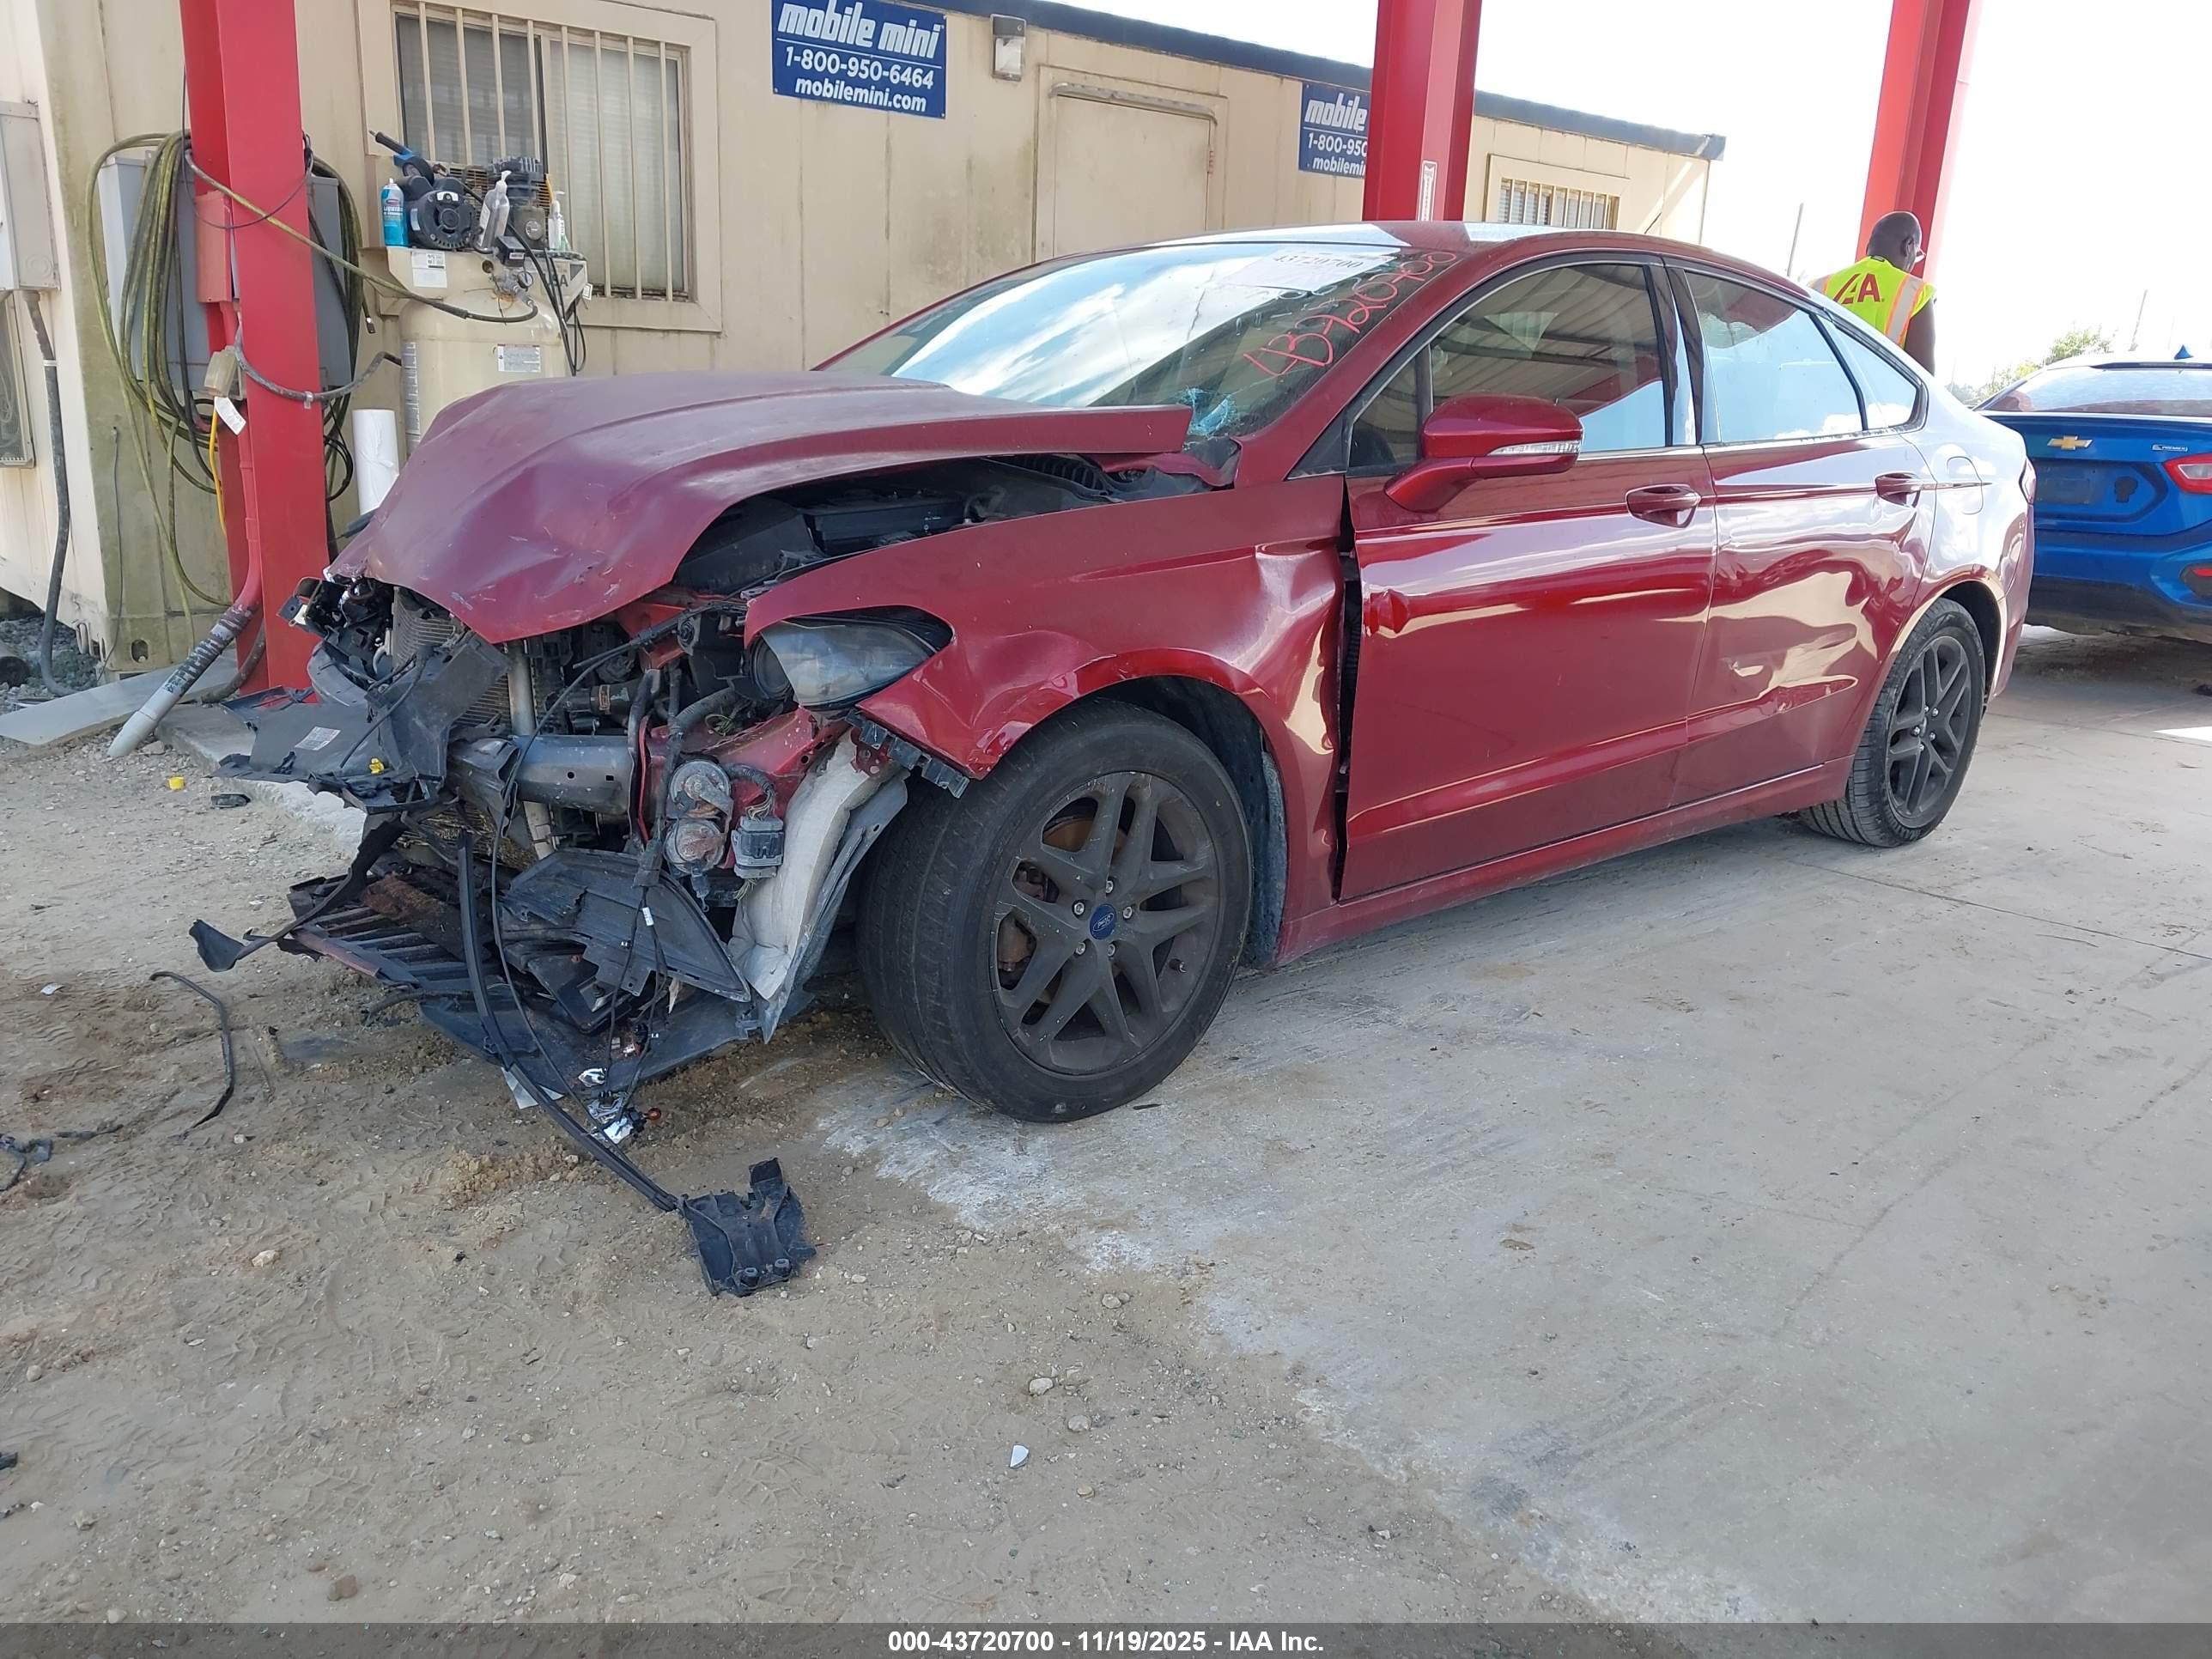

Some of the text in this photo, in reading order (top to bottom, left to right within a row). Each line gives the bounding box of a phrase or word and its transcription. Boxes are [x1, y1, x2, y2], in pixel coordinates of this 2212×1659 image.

[777, 0, 940, 58] mobile mini
[786, 46, 934, 89] 1-800-950-6464
[795, 78, 927, 112] mobilemini.com
[1304, 93, 1368, 131] mobile
